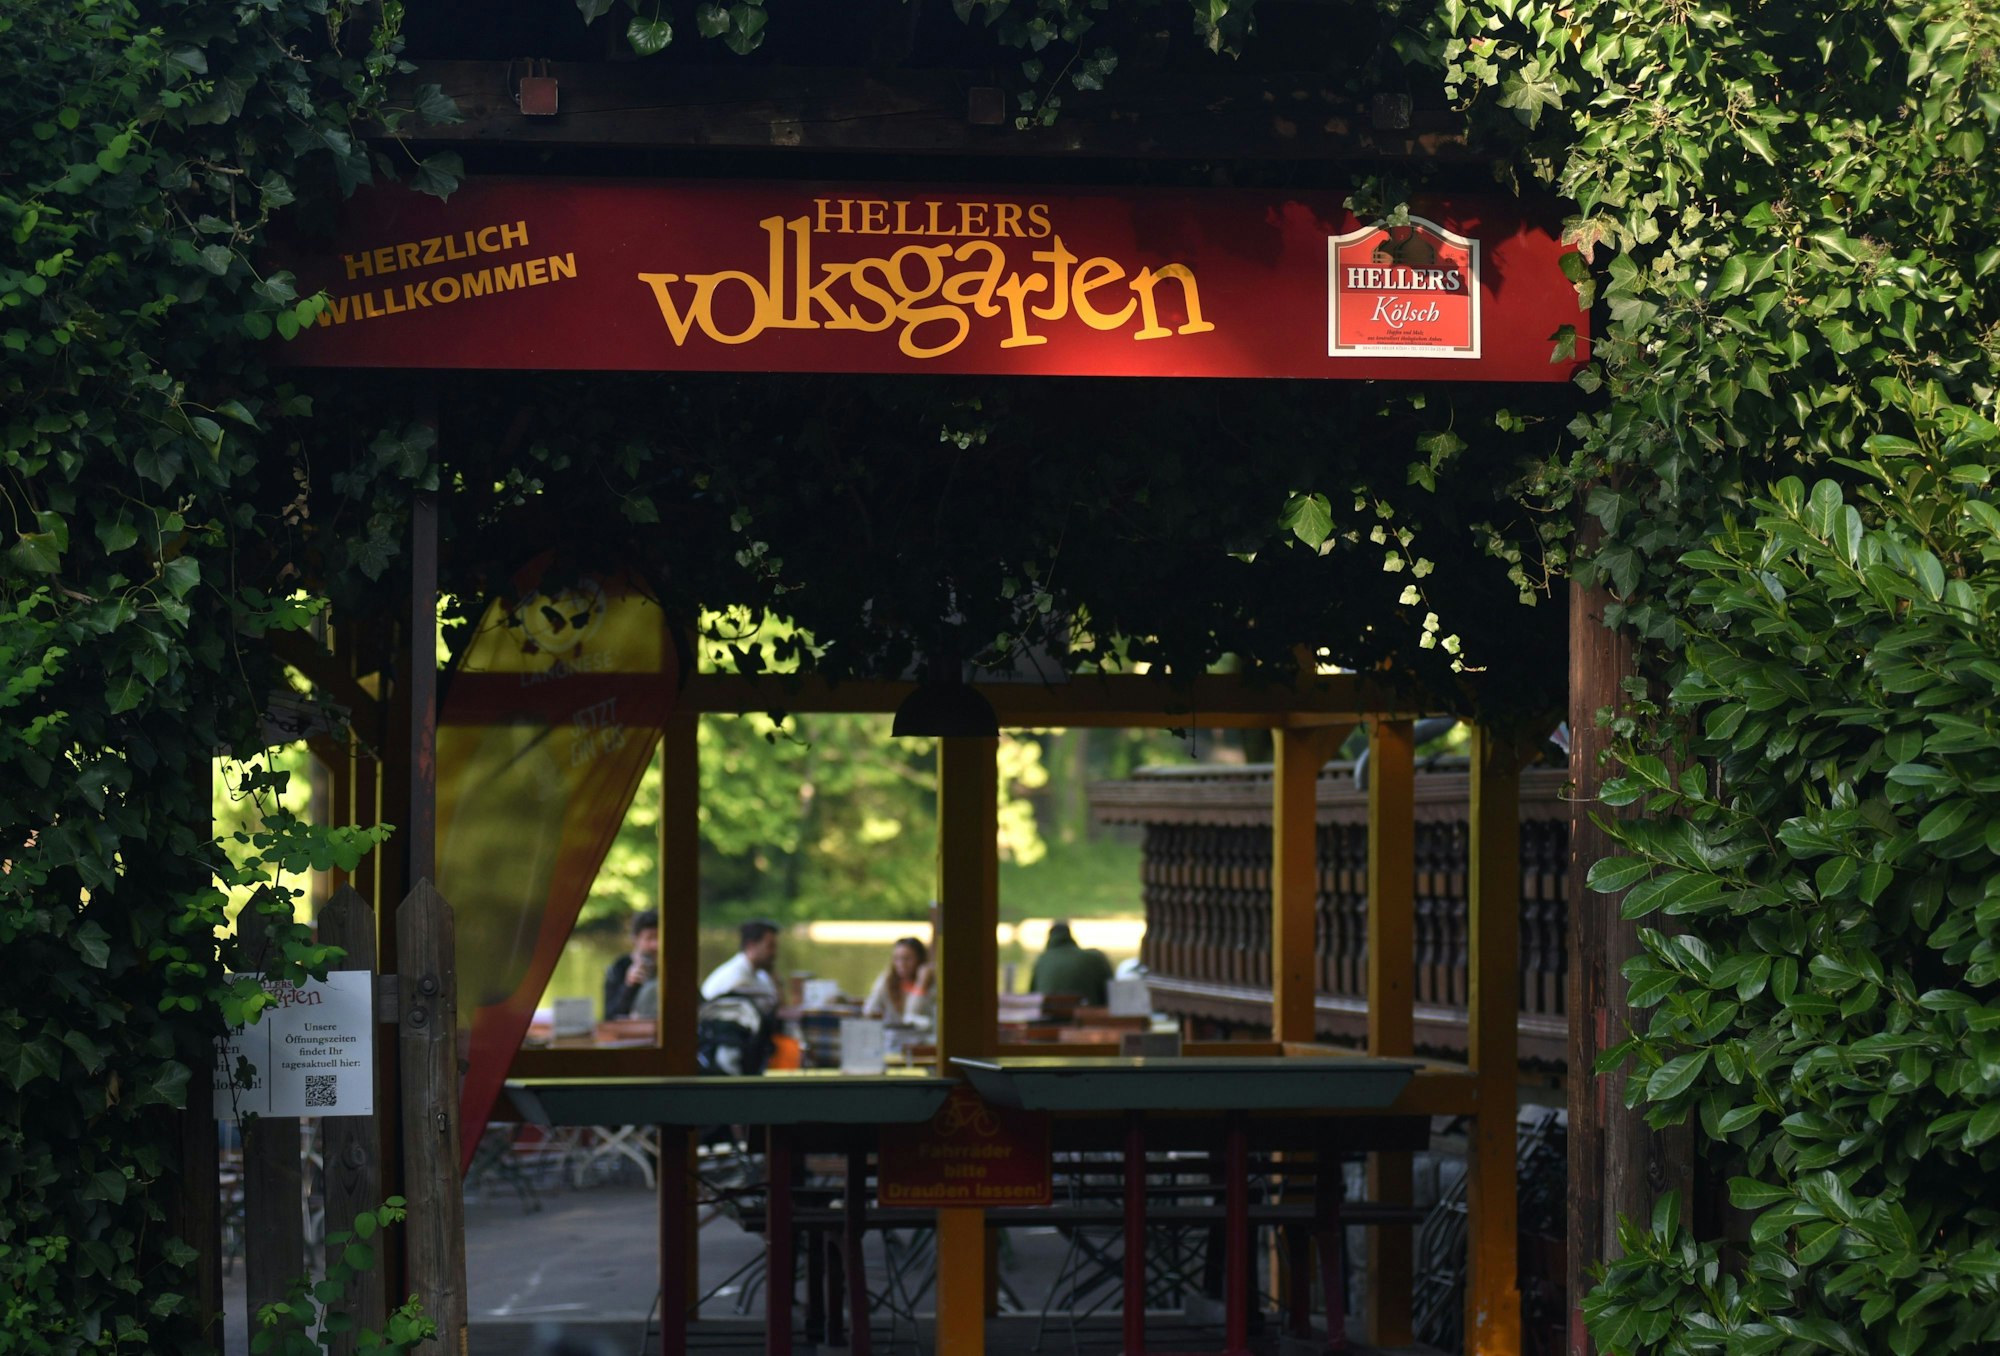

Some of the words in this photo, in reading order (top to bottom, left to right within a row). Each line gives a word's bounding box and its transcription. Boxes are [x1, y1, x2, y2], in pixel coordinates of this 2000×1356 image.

[813, 198, 1052, 239] HELLERS
[344, 220, 529, 281] HERZLICH
[638, 215, 1214, 358] volksgarten
[1347, 267, 1460, 291] HELLERS
[317, 252, 577, 328] WILLKOMMEN
[1370, 296, 1440, 329] Kölsch
[304, 1023, 337, 1032] Unsere
[285, 1034, 357, 1046] Öffnungszeiten
[299, 1047, 326, 1056] findet
[329, 1047, 343, 1056] Ihr
[282, 1058, 337, 1070] tagesaktuell
[340, 1059, 361, 1068] hier:
[919, 1144, 1013, 1159] Fahrräder
[944, 1163, 988, 1178] bitte
[887, 1183, 969, 1198] Draußen
[975, 1183, 1042, 1198] lassen!
